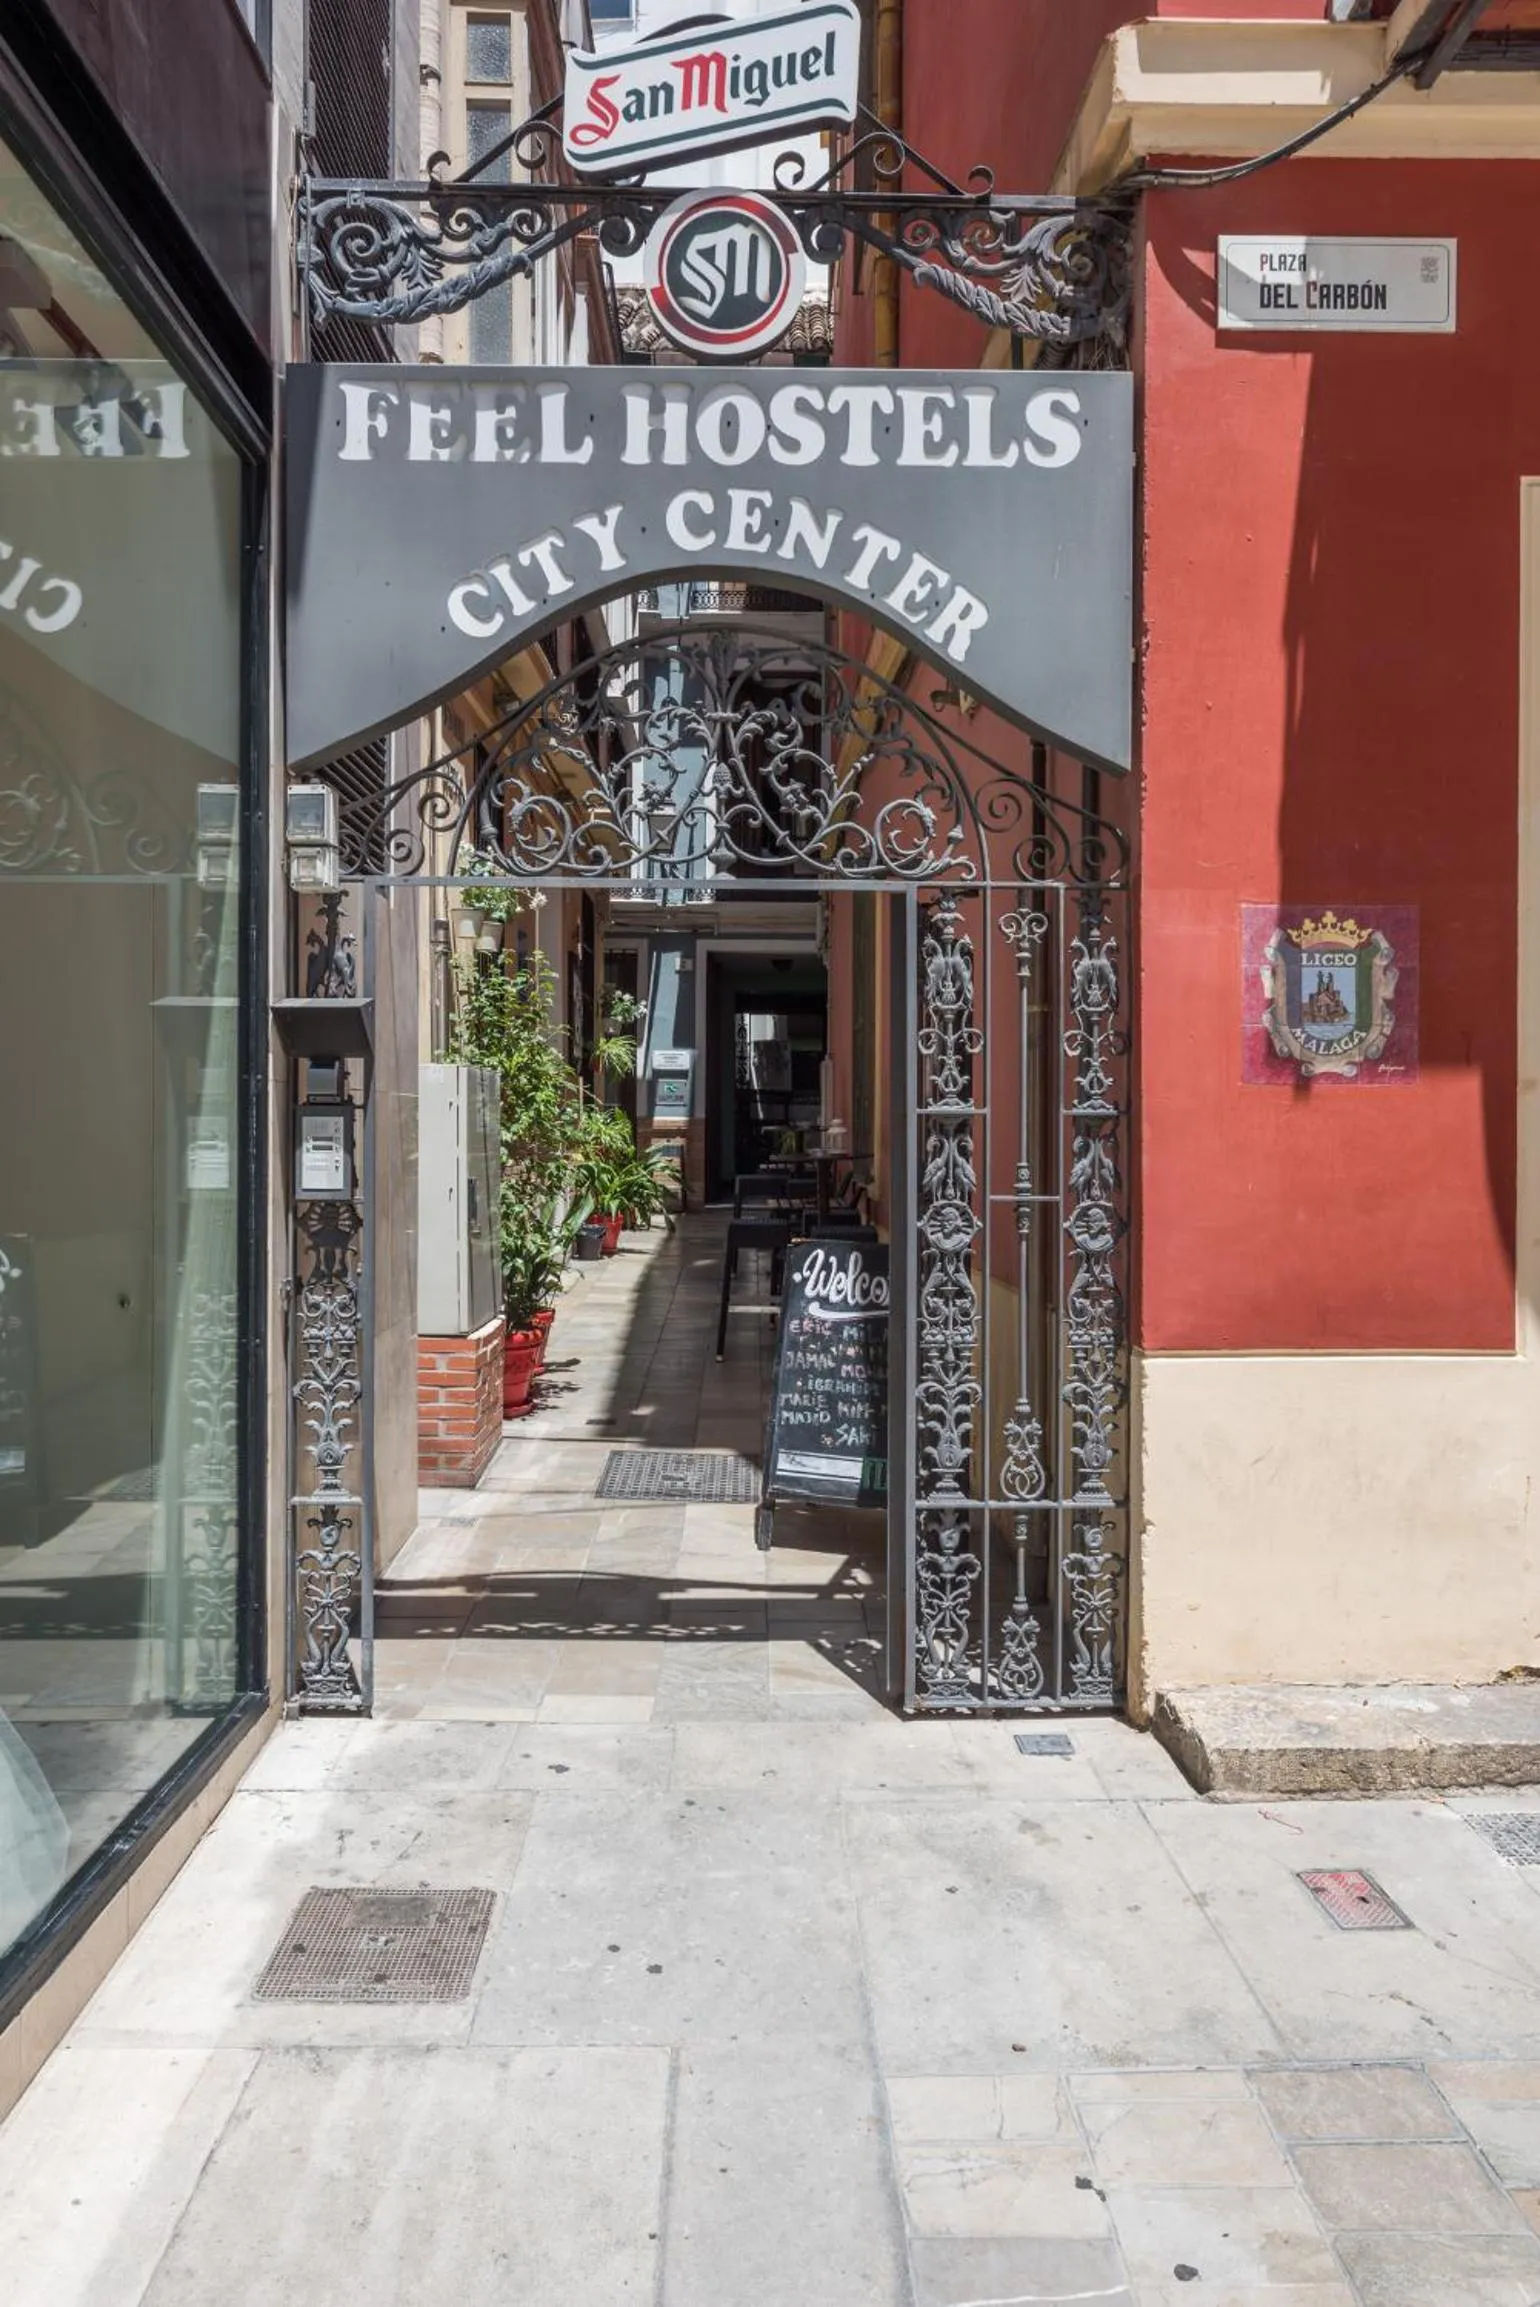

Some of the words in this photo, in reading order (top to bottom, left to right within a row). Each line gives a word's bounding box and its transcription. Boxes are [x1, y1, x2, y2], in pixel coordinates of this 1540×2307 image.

[1259, 253, 1308, 272] PLAZA
[1259, 283, 1299, 310] DEL
[1305, 279, 1388, 310] CARBÓN
[337, 381, 595, 466] FEEL
[620, 383, 1083, 469] HOSTELS
[447, 502, 627, 638] CITY
[665, 488, 989, 663] CENTER
[1301, 952, 1358, 967] LICEO
[802, 1248, 890, 1306] Welco
